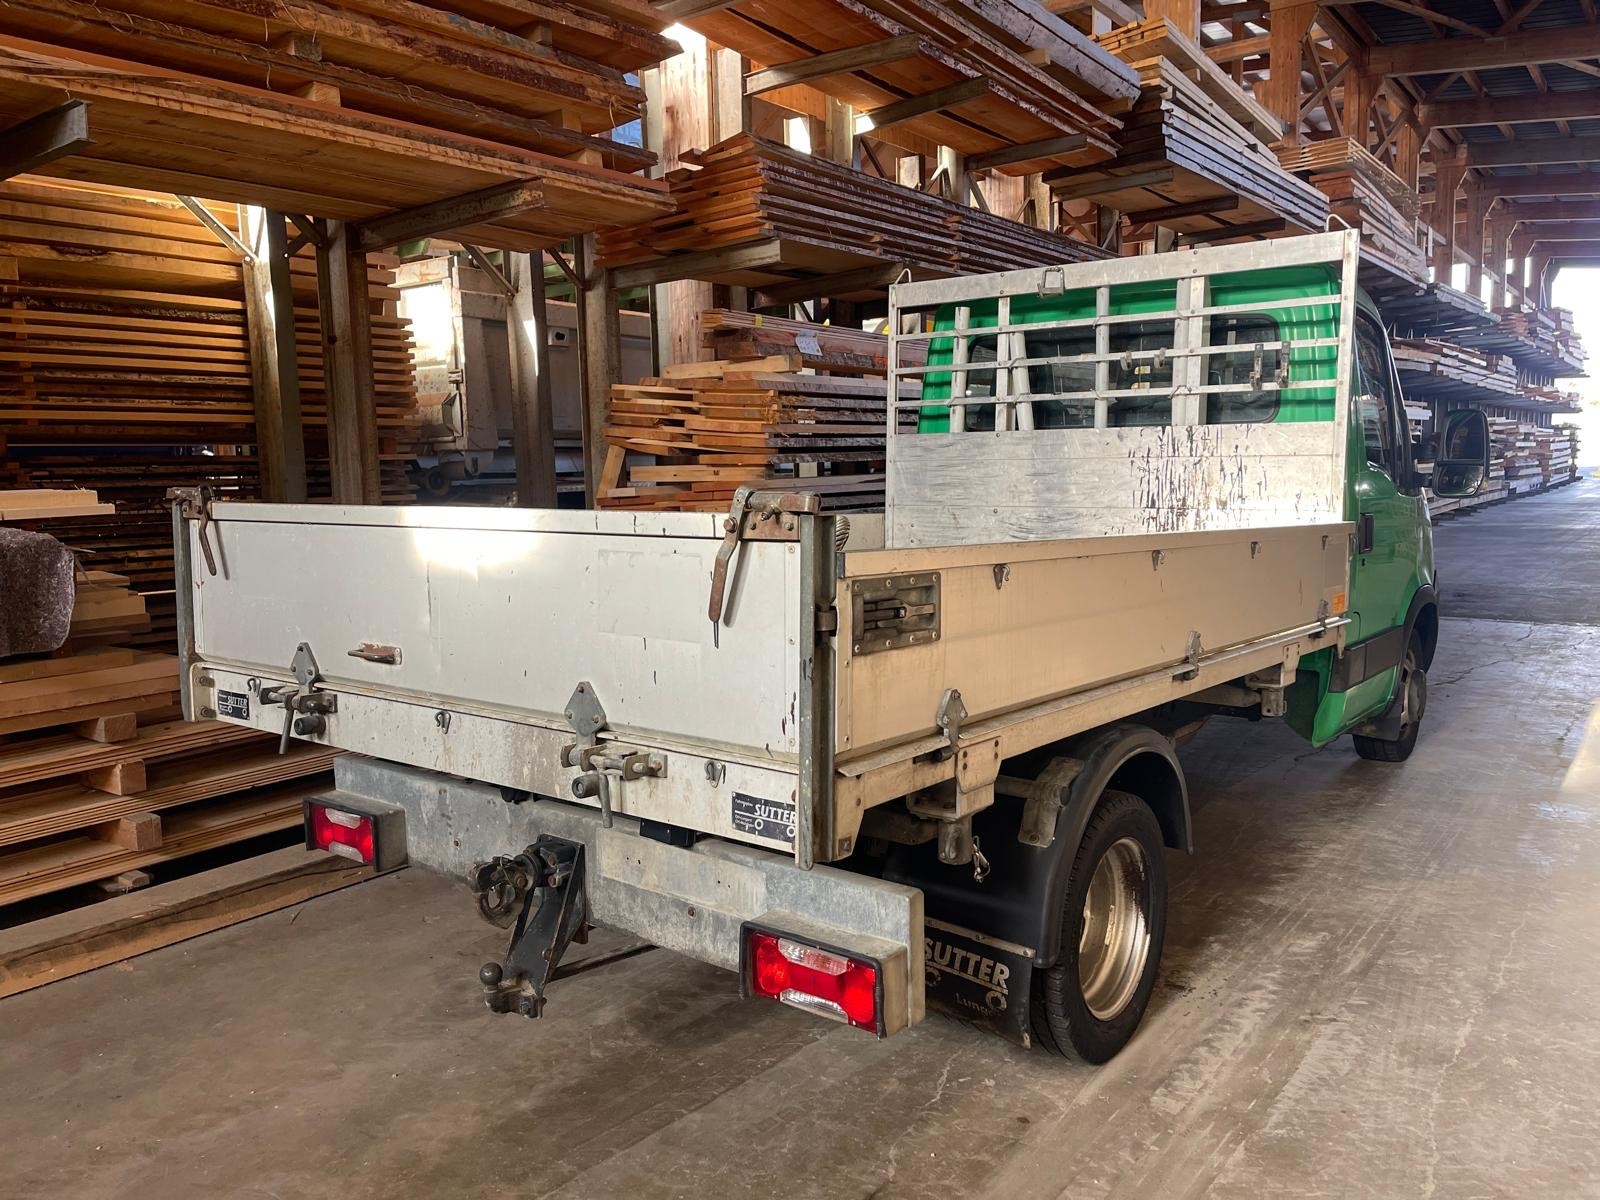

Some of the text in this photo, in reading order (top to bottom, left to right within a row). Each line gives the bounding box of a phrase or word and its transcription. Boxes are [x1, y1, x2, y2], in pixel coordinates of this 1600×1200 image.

[227, 695, 248, 707] SUTTER
[754, 804, 796, 824] SUTTER
[924, 937, 1010, 989] SUTTER
